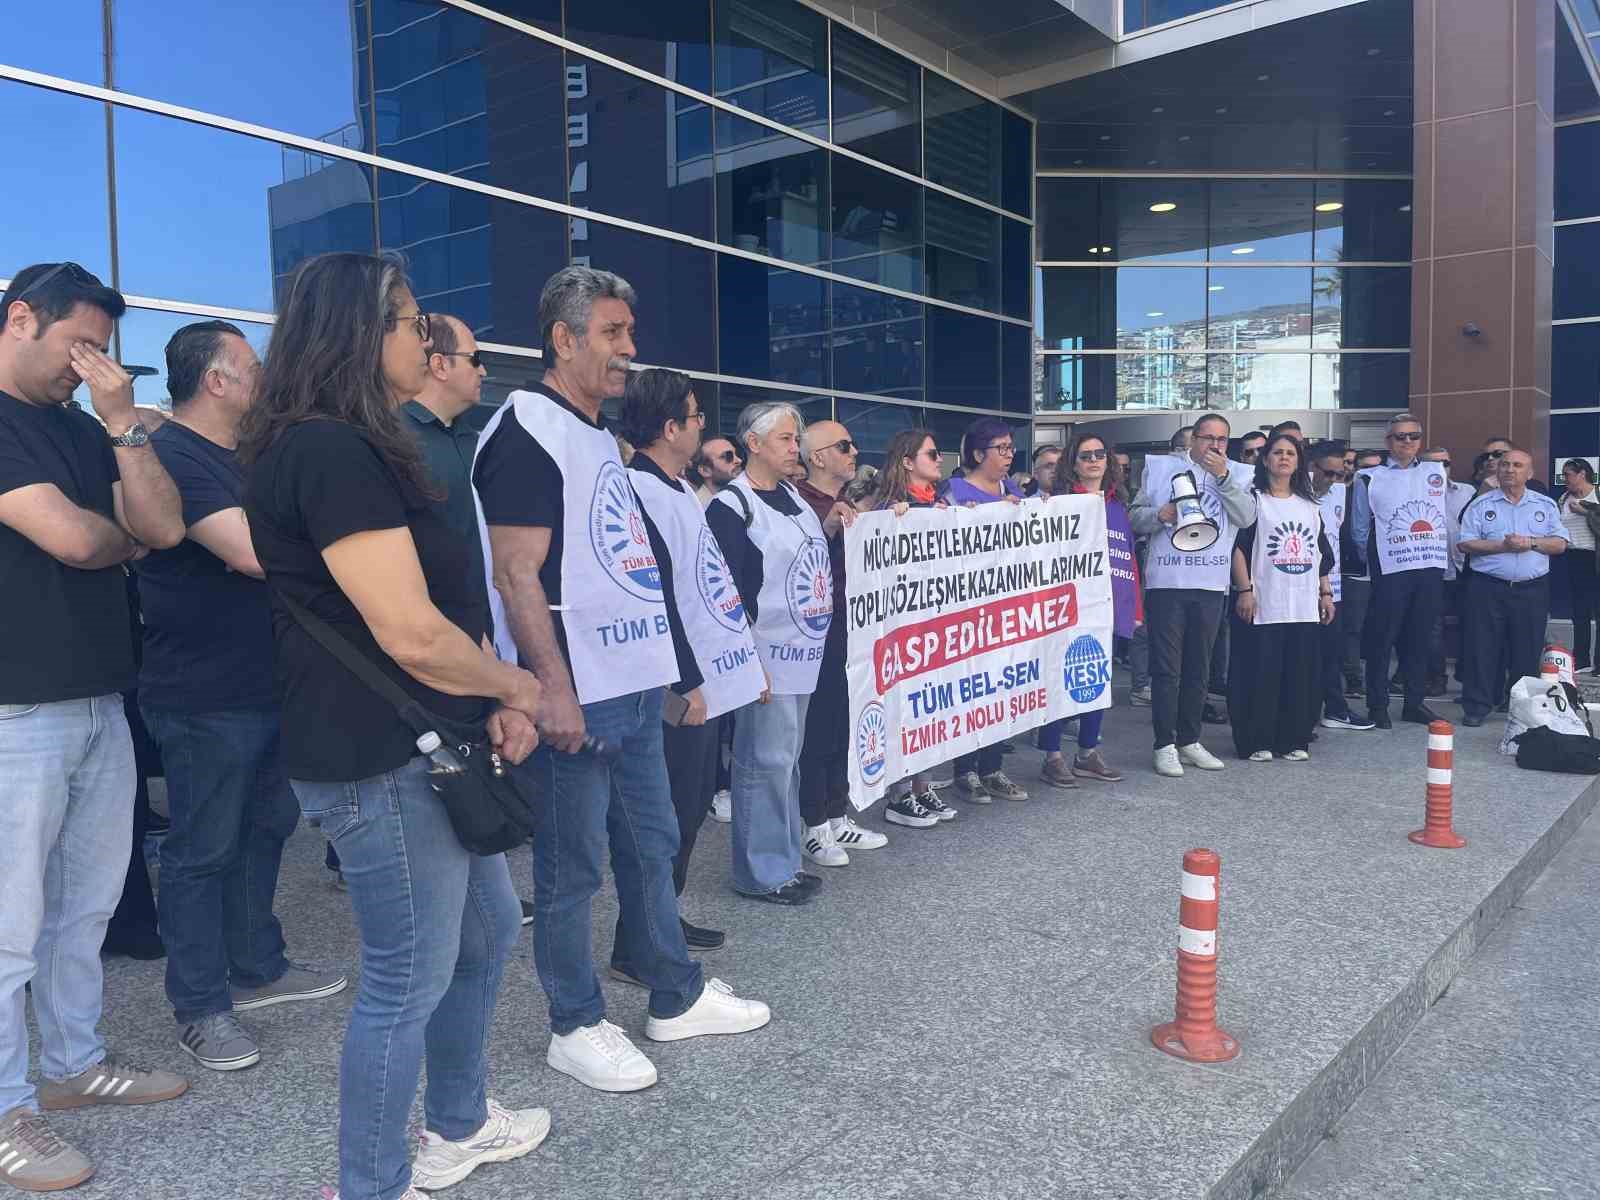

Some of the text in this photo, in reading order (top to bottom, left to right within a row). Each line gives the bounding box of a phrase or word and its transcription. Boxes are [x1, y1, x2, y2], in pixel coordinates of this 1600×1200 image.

[1157, 555, 1180, 566] TÜM
[850, 551, 1104, 631] TOPLU SÖZLEŞME KAZANIMLARIMIZ
[597, 618, 649, 647] TÜM
[881, 594, 1071, 686] GASP EDİLEMEZ
[711, 646, 748, 675] TÜM
[769, 643, 804, 662] TÜM
[907, 658, 1040, 719] TÜM BEL-SEN
[1063, 660, 1111, 691] KESK
[900, 688, 1047, 757] İZMİR 2 NOLU ŞUBE
